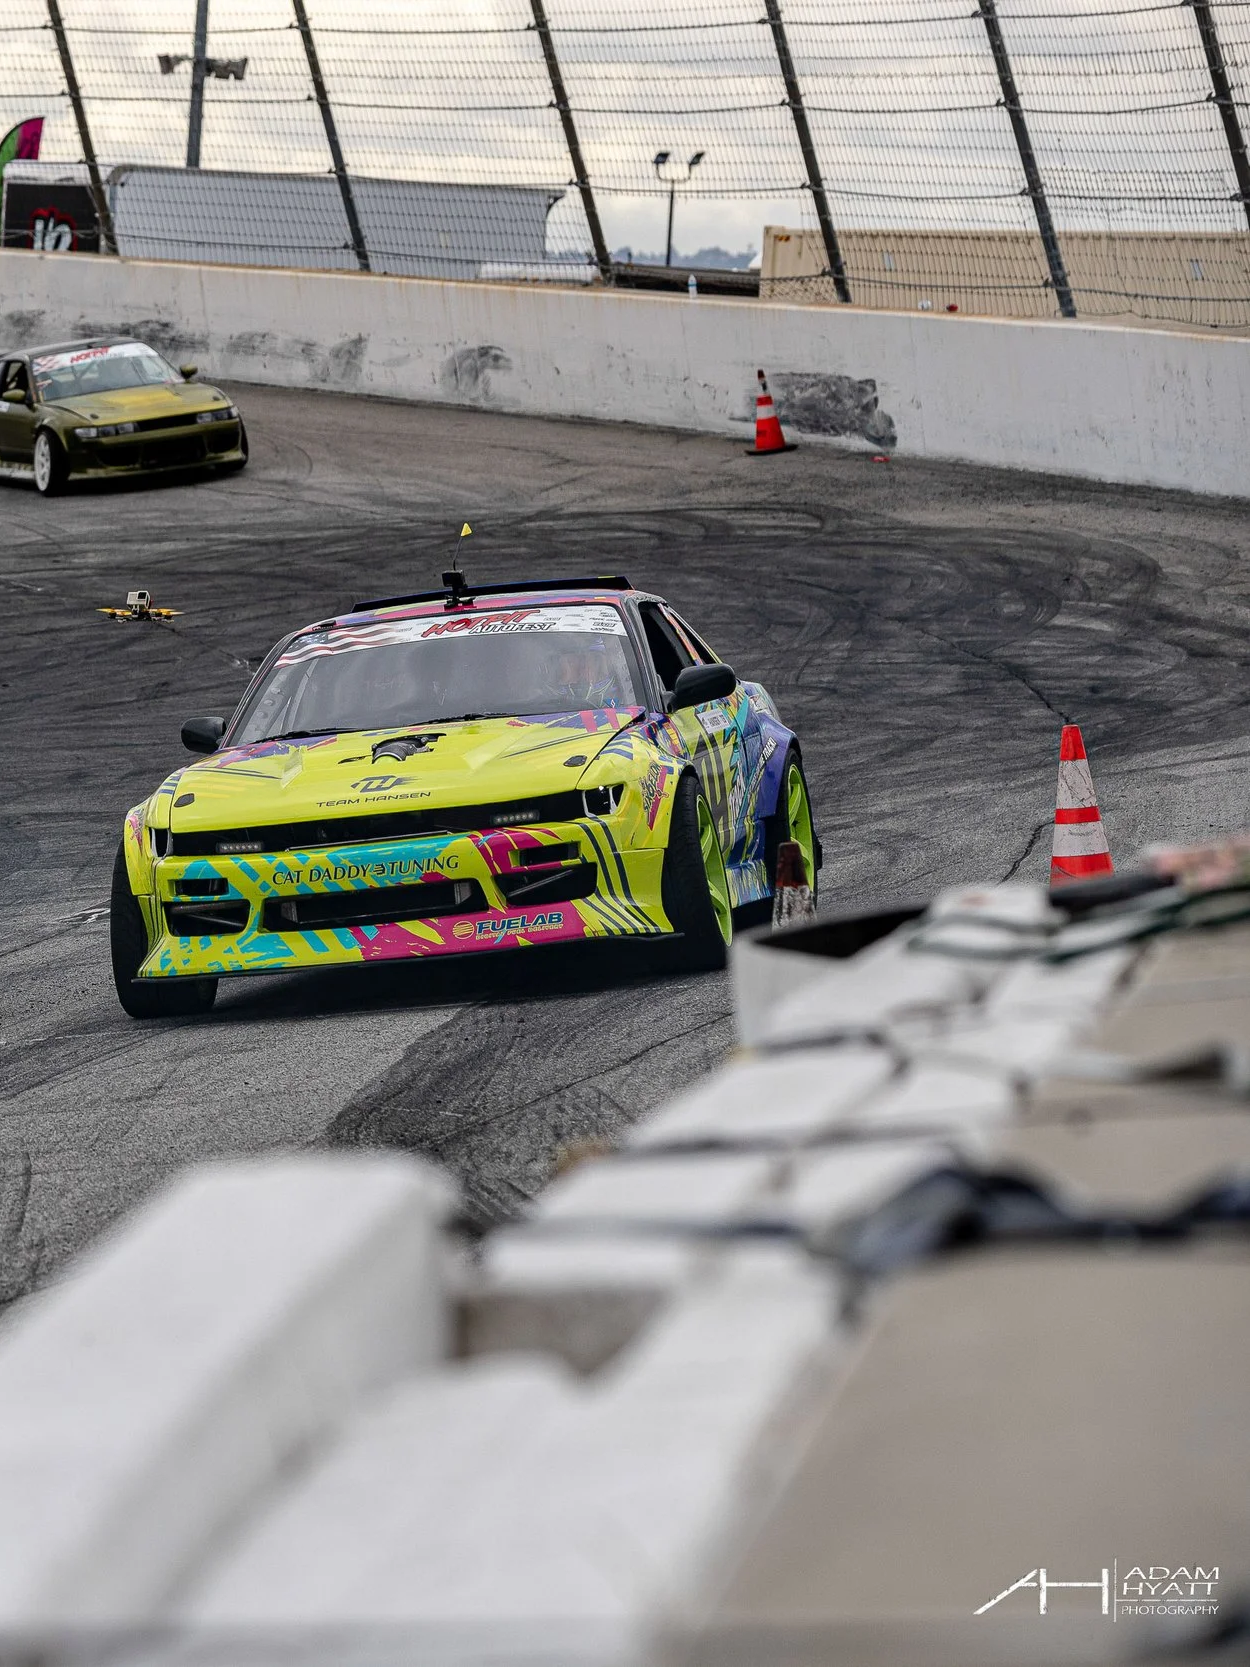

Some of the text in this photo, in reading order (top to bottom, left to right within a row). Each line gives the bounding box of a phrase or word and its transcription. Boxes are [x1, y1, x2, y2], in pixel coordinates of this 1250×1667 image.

[421, 610, 541, 637] HOTPIT
[469, 622, 557, 635] AUTOFEST
[316, 791, 431, 808] TEAM HANSEN
[272, 855, 459, 885] CAT DADDY TUNING
[476, 911, 564, 935] FUELAB
